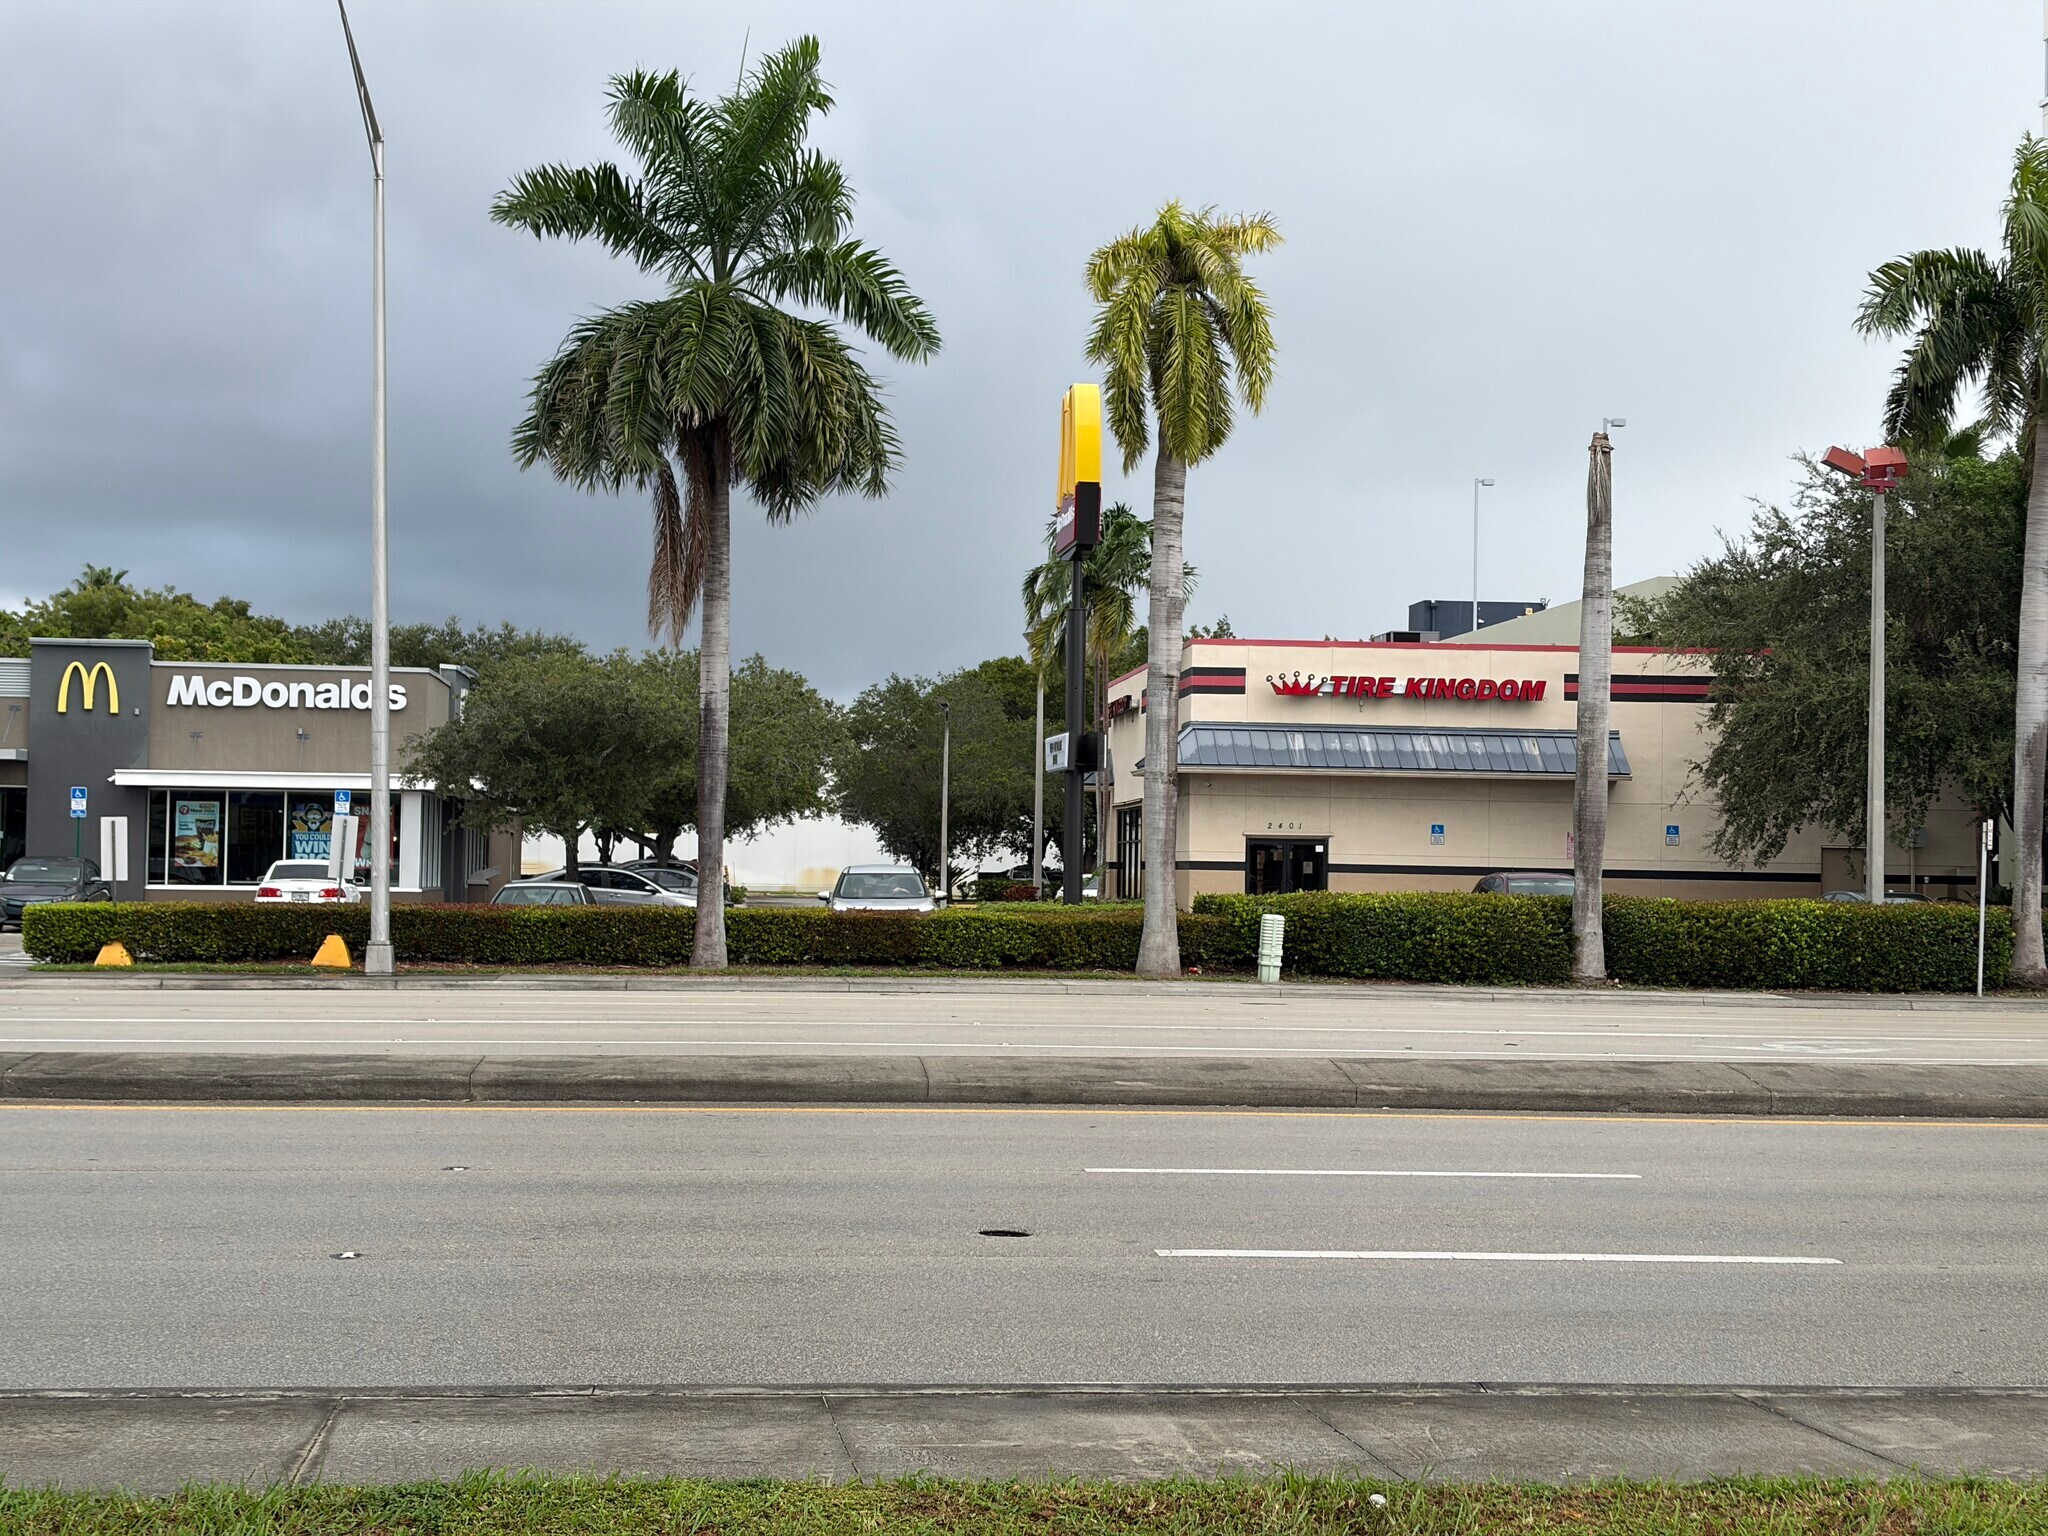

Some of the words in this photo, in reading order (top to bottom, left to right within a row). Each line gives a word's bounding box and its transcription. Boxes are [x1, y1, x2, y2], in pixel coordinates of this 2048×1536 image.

[166, 674, 408, 711] McDonalds
[1329, 675, 1397, 699] TIRE
[1404, 677, 1548, 702] KINGDOM
[1267, 822, 1303, 830] 2401
[295, 833, 309, 841] YOU
[294, 840, 331, 854] WIN
